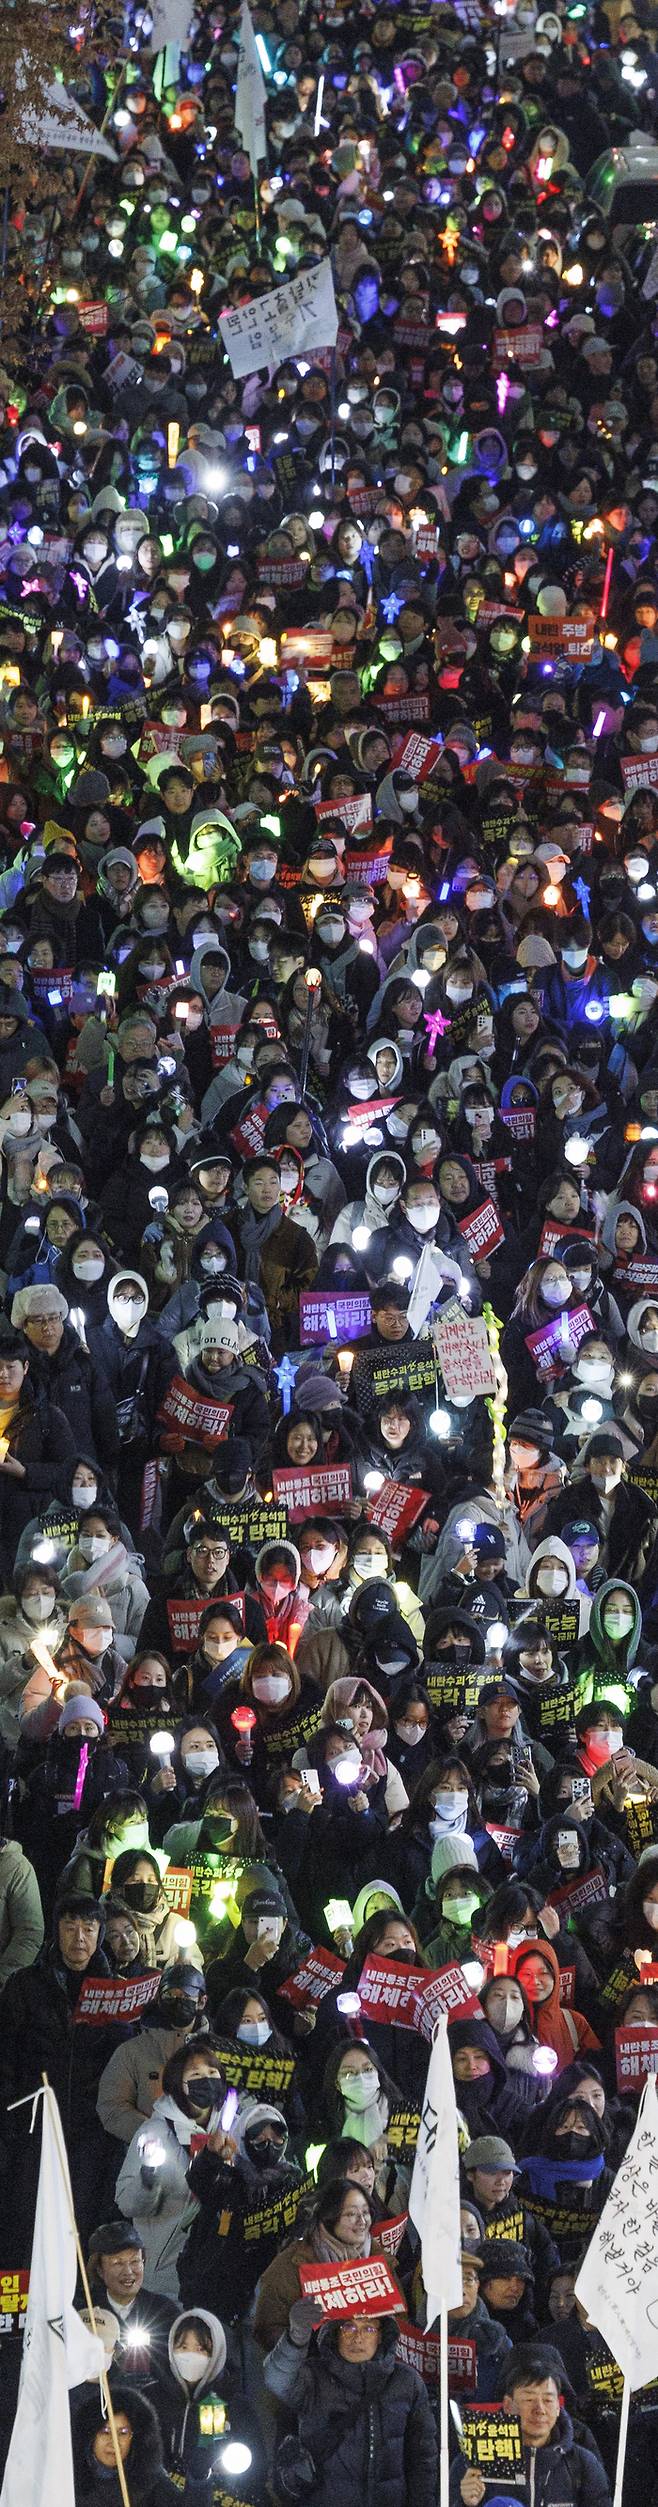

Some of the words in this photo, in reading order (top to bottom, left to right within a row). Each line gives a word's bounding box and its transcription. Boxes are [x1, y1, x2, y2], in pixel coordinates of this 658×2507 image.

[562, 623, 587, 637] 주범
[568, 642, 592, 656] 퇴진
[373, 1364, 408, 1380] 내란수괴
[276, 1478, 312, 1492] 내란동조
[311, 1469, 350, 1486] 국민의힘
[277, 1482, 350, 1510] 해체하라!
[259, 1510, 287, 1523] 윤석열
[249, 1523, 288, 1543] 탄핵!
[426, 1674, 467, 1688] 내란수괴
[427, 1688, 460, 1708] 즉각
[365, 1969, 408, 1986] 내란동조
[423, 1967, 464, 2001] 국민의힘
[80, 1986, 159, 2016] 해체하라!
[84, 1988, 126, 1999] 내란동조
[246, 2068, 293, 2091] 탄핵!
[303, 2274, 341, 2295] 내란동조
[340, 2262, 388, 2288] 국민의힘
[487, 2422, 521, 2438] 윤석열
[477, 2438, 522, 2462] 탄핵!
